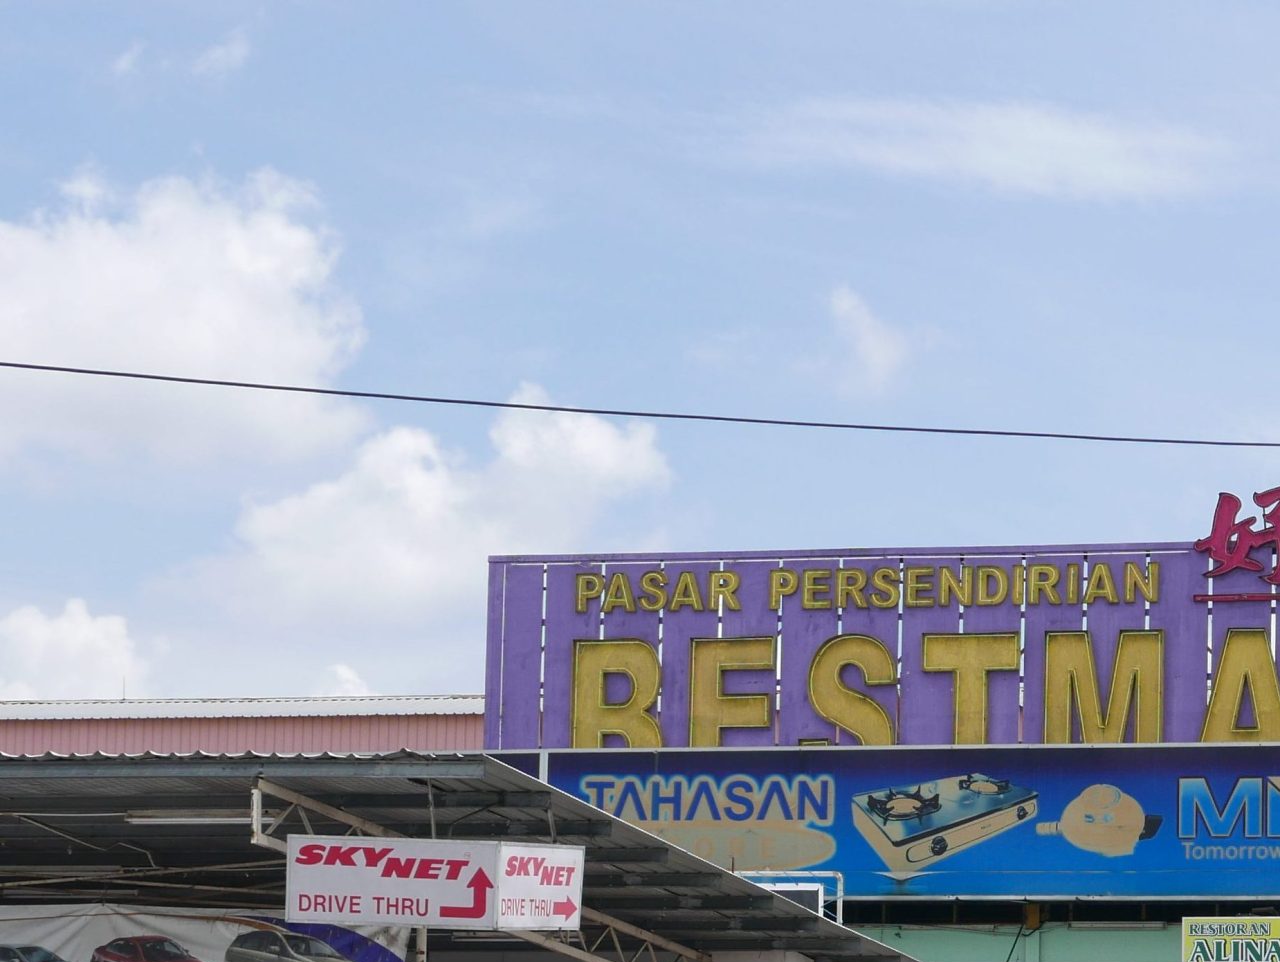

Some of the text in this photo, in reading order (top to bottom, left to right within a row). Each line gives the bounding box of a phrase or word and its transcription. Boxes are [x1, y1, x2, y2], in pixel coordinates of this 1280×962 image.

[574, 561, 1160, 614] PASAR PERSENDIRIAN
[584, 779, 830, 822] TAHASAN
[295, 844, 470, 881] SKYNET
[505, 855, 576, 887] SKYNET
[298, 894, 429, 917] DRIVE THRU
[501, 898, 551, 918] DRIVE THRU
[1188, 921, 1271, 937] RESTORAN
